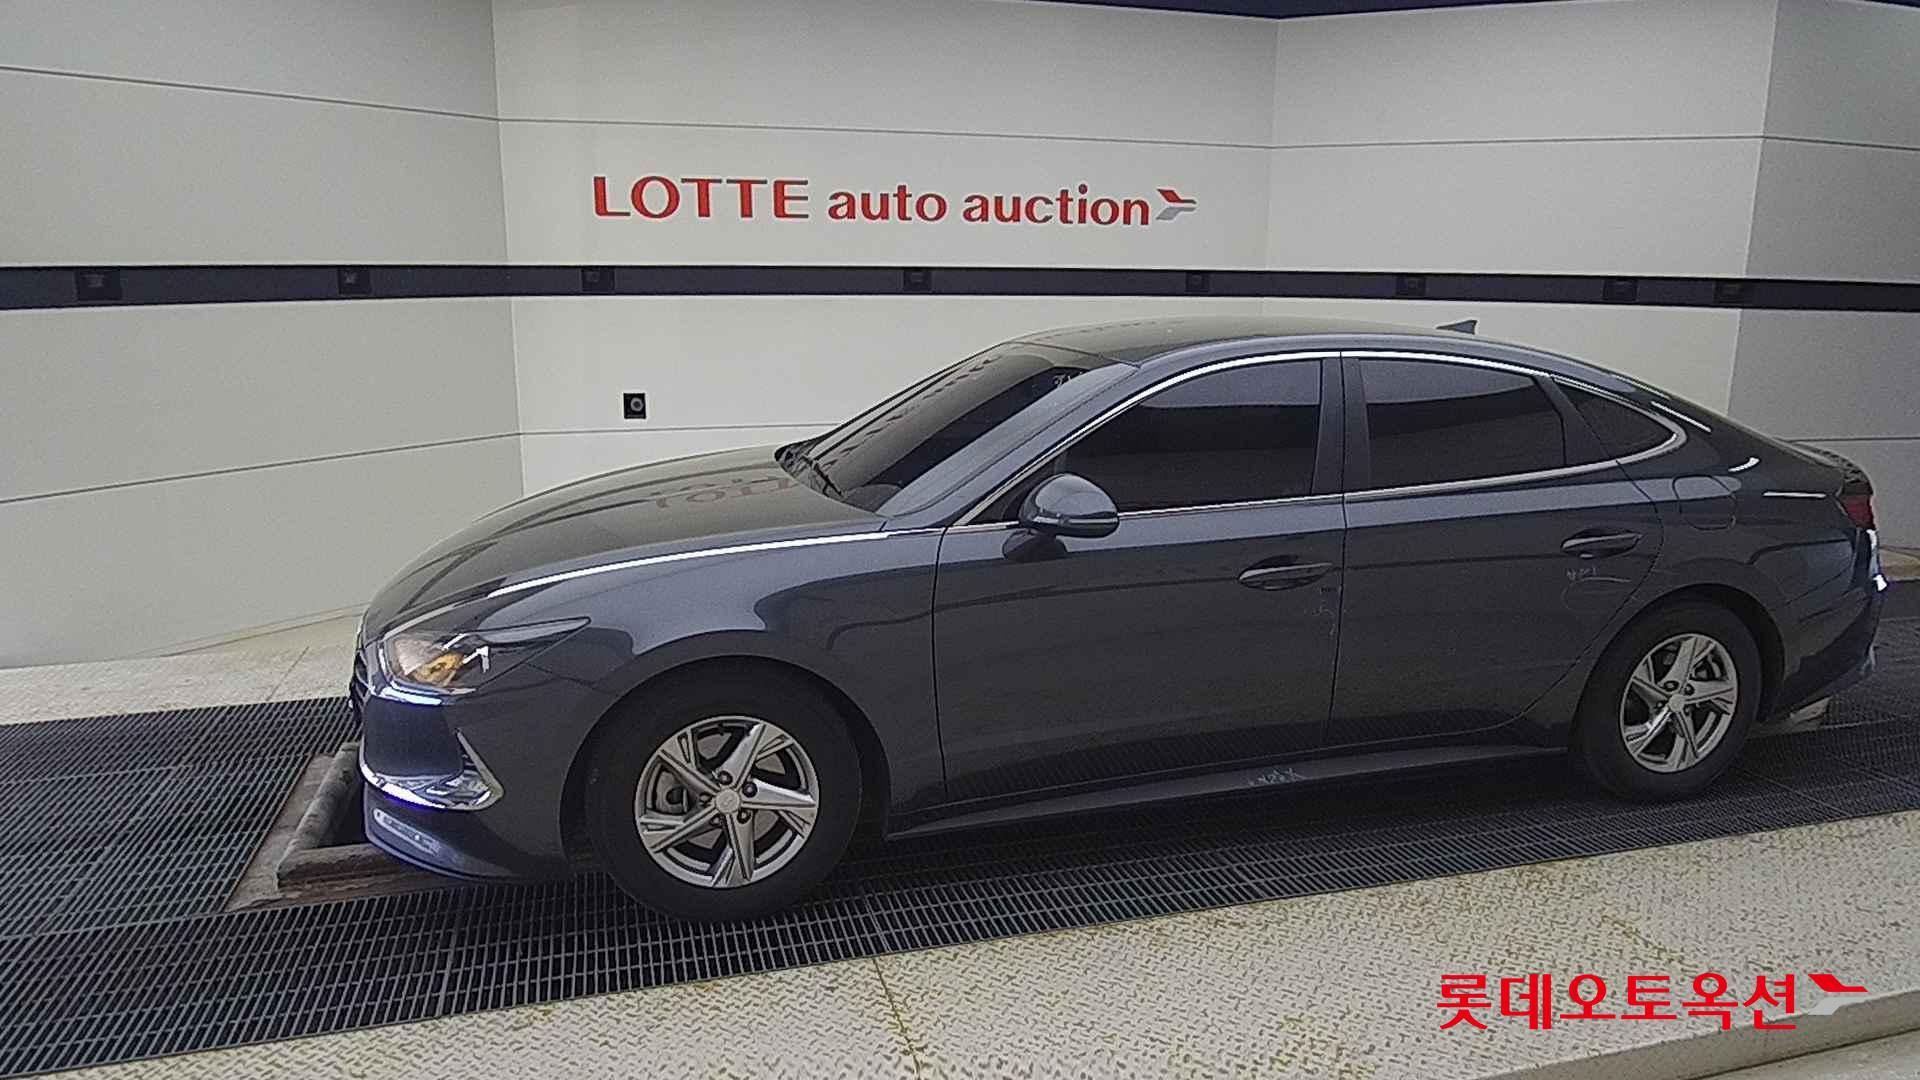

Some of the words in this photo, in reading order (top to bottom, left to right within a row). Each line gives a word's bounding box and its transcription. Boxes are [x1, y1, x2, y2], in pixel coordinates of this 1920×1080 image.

[593, 176, 808, 220] LOTTE
[827, 184, 947, 222] auto
[962, 183, 1150, 226] auction
